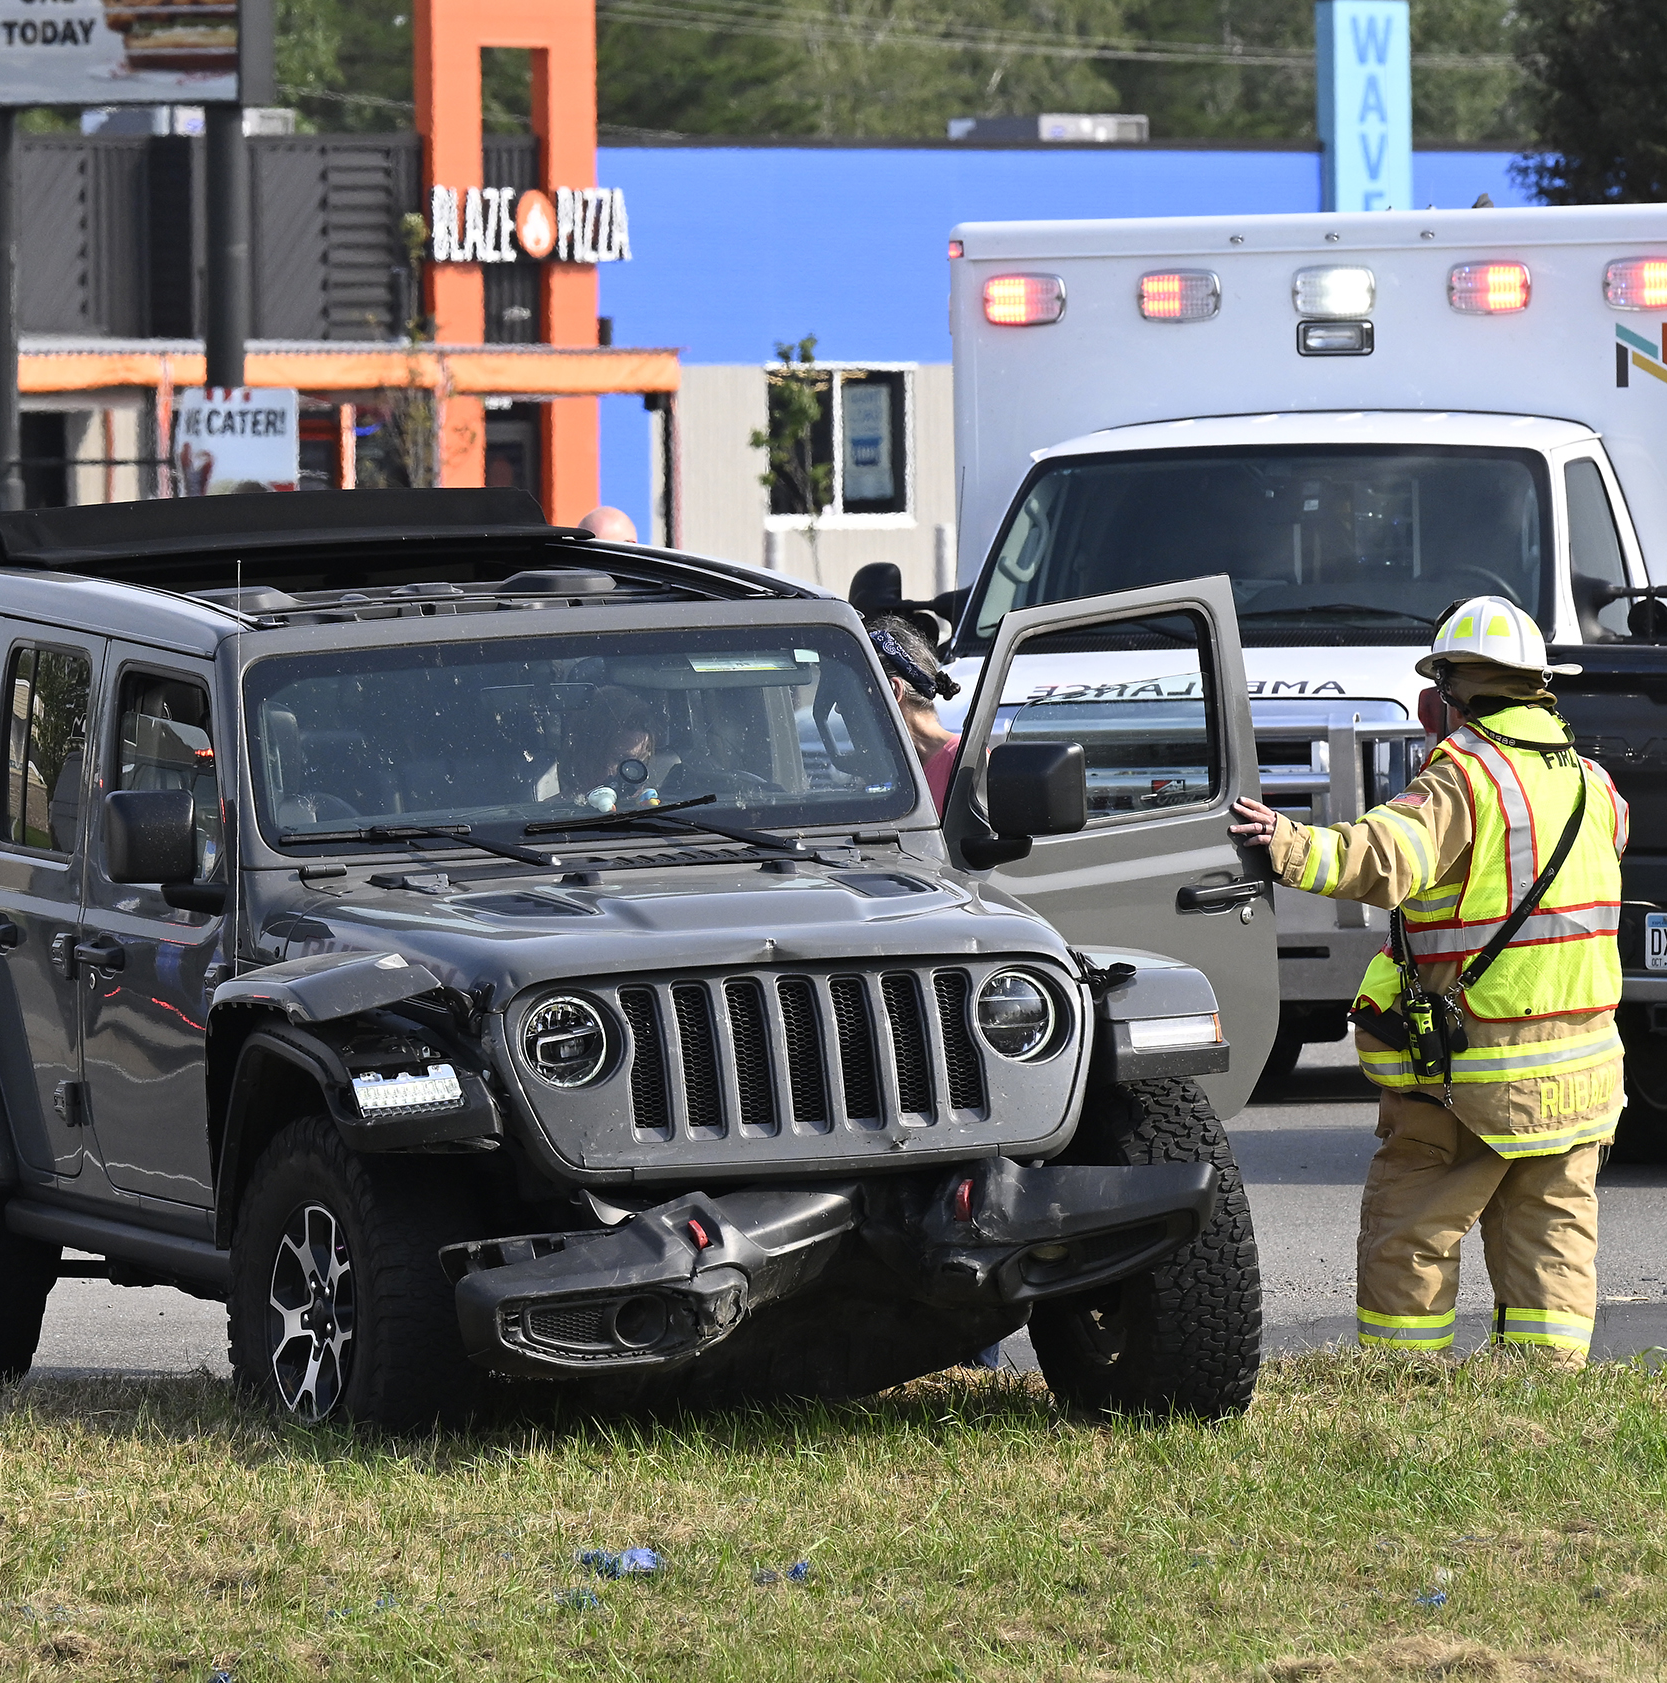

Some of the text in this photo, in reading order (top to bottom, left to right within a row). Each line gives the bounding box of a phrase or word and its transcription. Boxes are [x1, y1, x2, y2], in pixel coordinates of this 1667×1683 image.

[0, 18, 96, 46] TODAY
[431, 184, 632, 263] BLAZE PIZZA
[206, 409, 286, 437] CATER!
